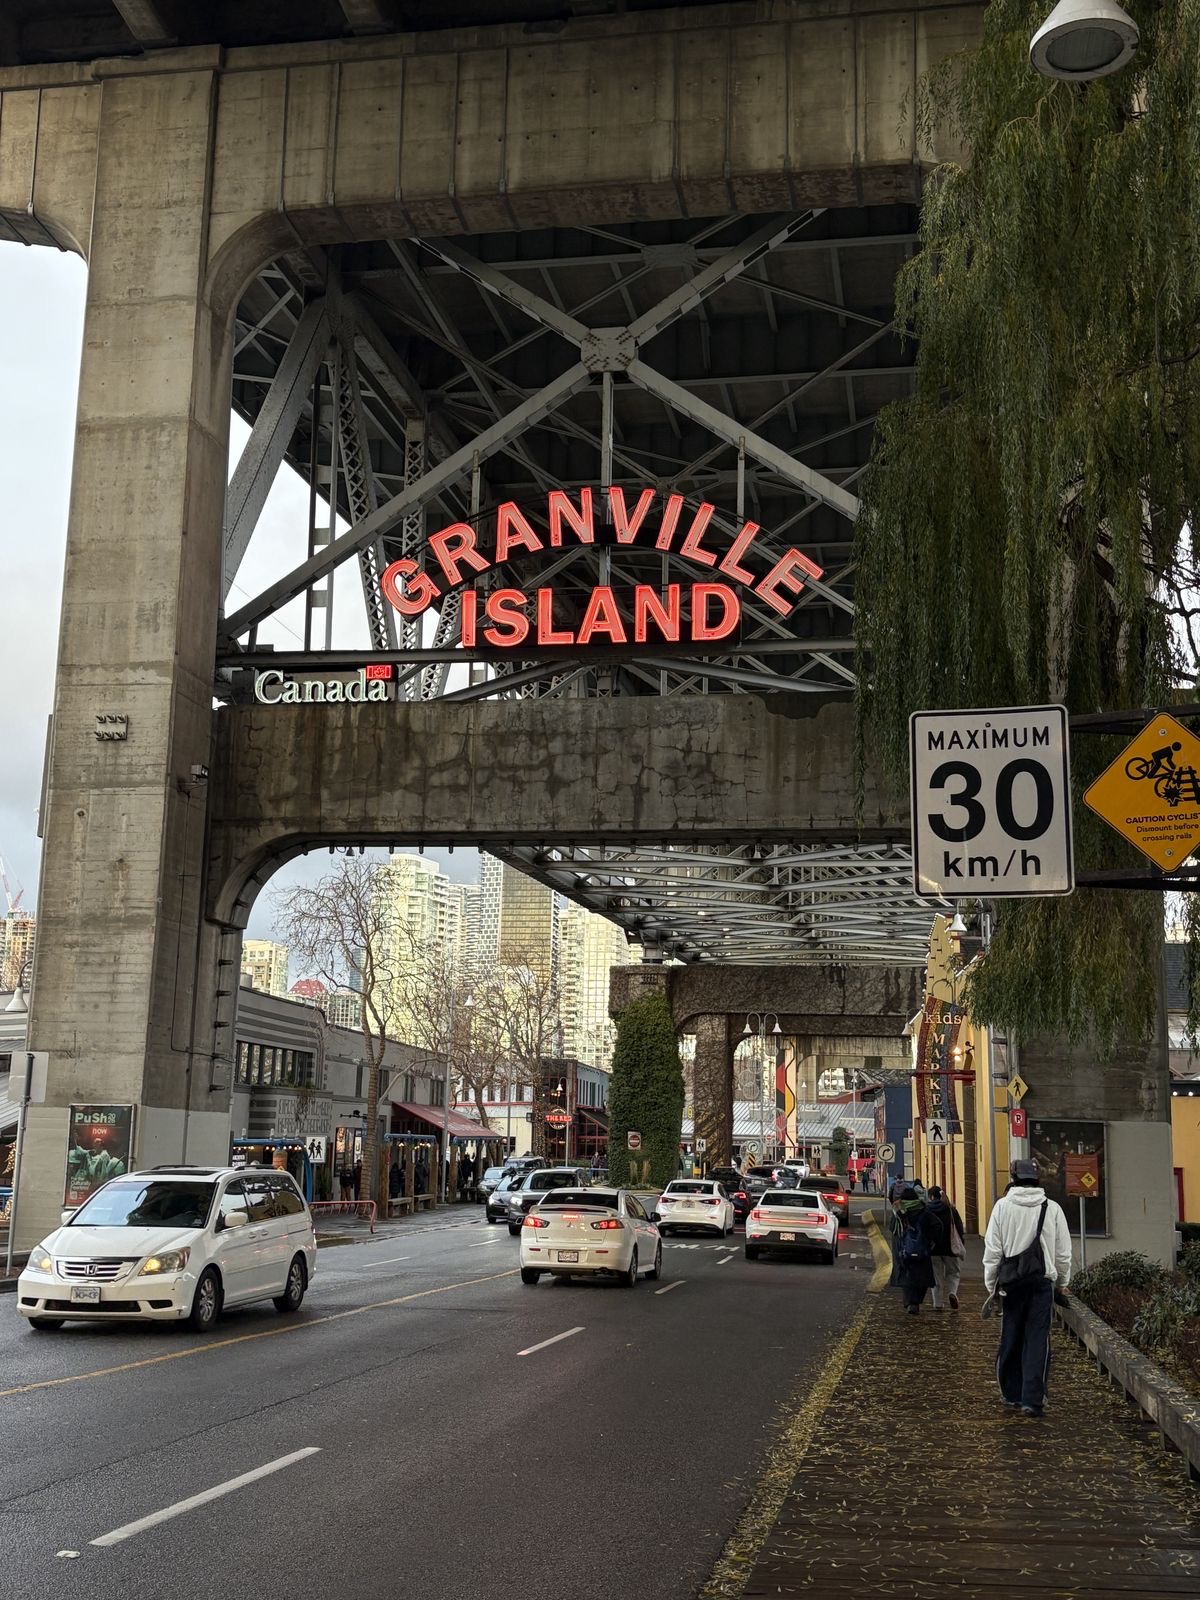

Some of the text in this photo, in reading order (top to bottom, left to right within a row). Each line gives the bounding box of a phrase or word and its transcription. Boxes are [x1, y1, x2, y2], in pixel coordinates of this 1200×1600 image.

[380, 486, 824, 618] GRANVILLE
[461, 583, 742, 648] ISLAND
[255, 667, 389, 704] Canada
[927, 726, 1050, 750] MAXIMUM
[928, 758, 1054, 842] 30
[1125, 815, 1166, 824] CAUTION
[1136, 825, 1172, 833] Dismount
[1142, 832, 1193, 842] crossing rails
[943, 850, 1041, 877] km/h
[924, 1011, 962, 1025] kids
[74, 1112, 108, 1123] PuSh
